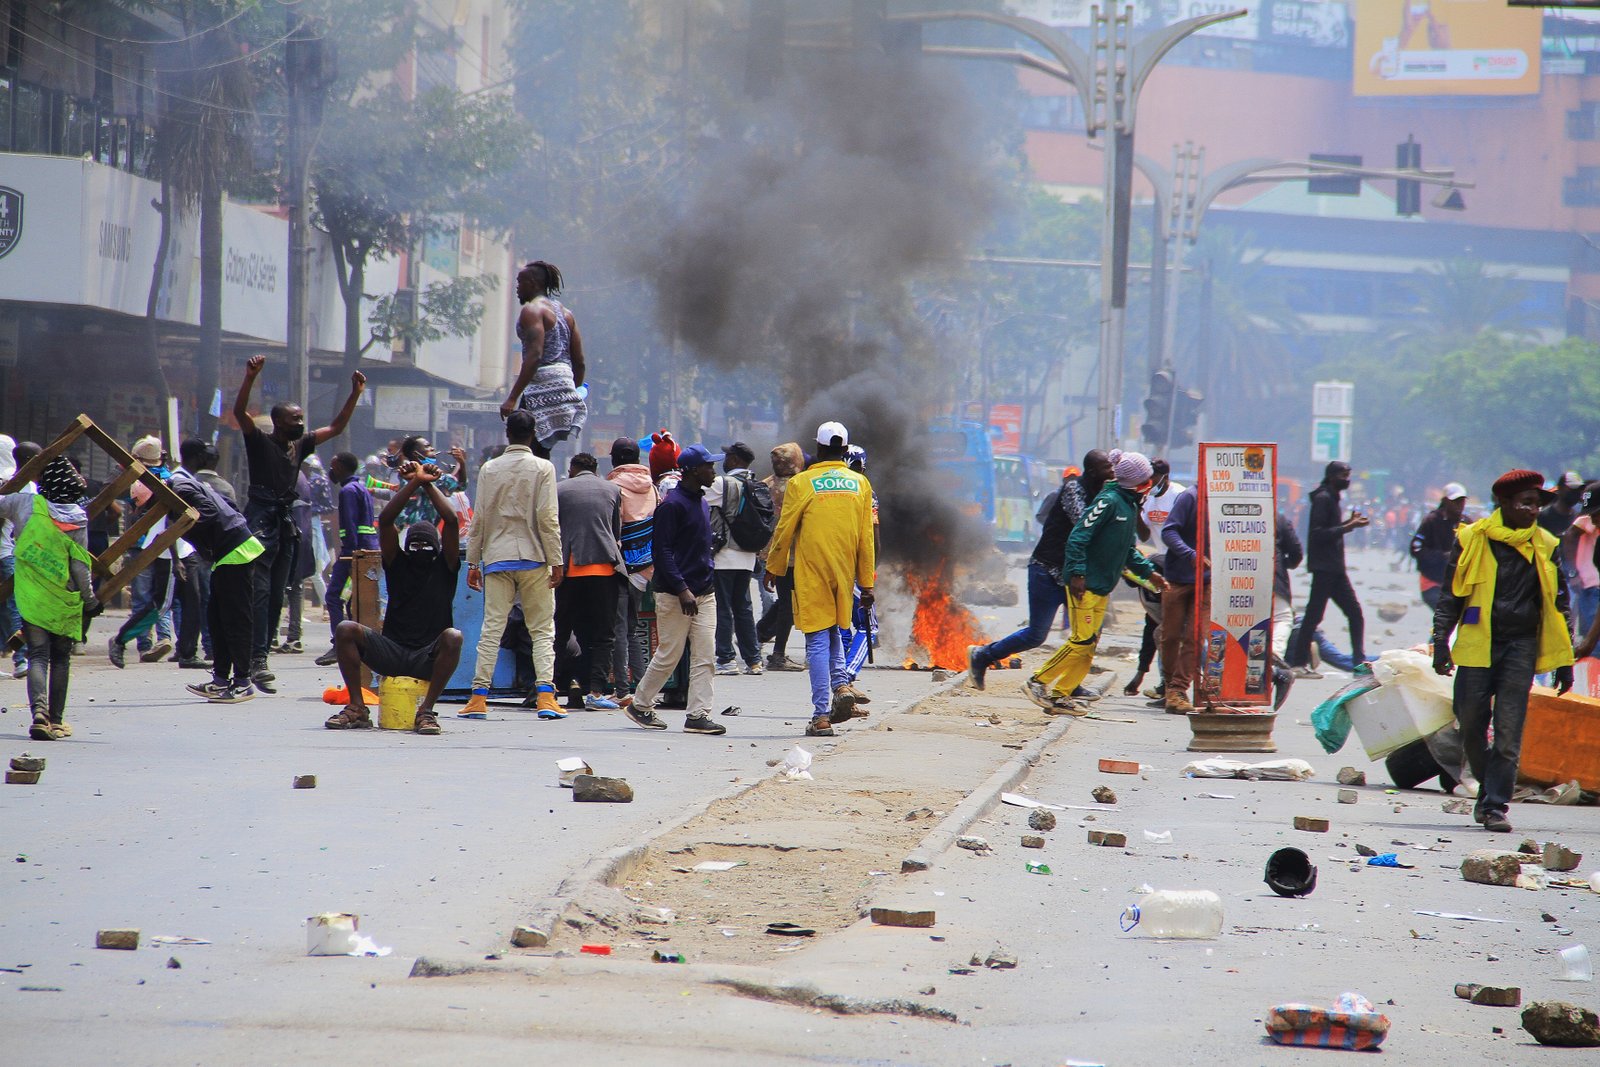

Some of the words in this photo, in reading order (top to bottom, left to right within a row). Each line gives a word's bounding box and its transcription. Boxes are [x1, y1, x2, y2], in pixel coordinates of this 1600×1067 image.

[99, 220, 131, 263] SAMSUNG
[226, 246, 248, 296] Galaxy
[258, 256, 276, 293] Series
[1216, 452, 1245, 467] ROUTE
[815, 478, 856, 490] SOKO
[1209, 481, 1235, 492] SACCO
[1218, 521, 1267, 534] WESTLANDS
[1225, 539, 1261, 552] KANGEMI
[1228, 558, 1258, 571] UTHIRU
[1231, 576, 1255, 589] KINOO
[1229, 595, 1254, 608] REGEN
[1227, 614, 1255, 627] KIKUYU
